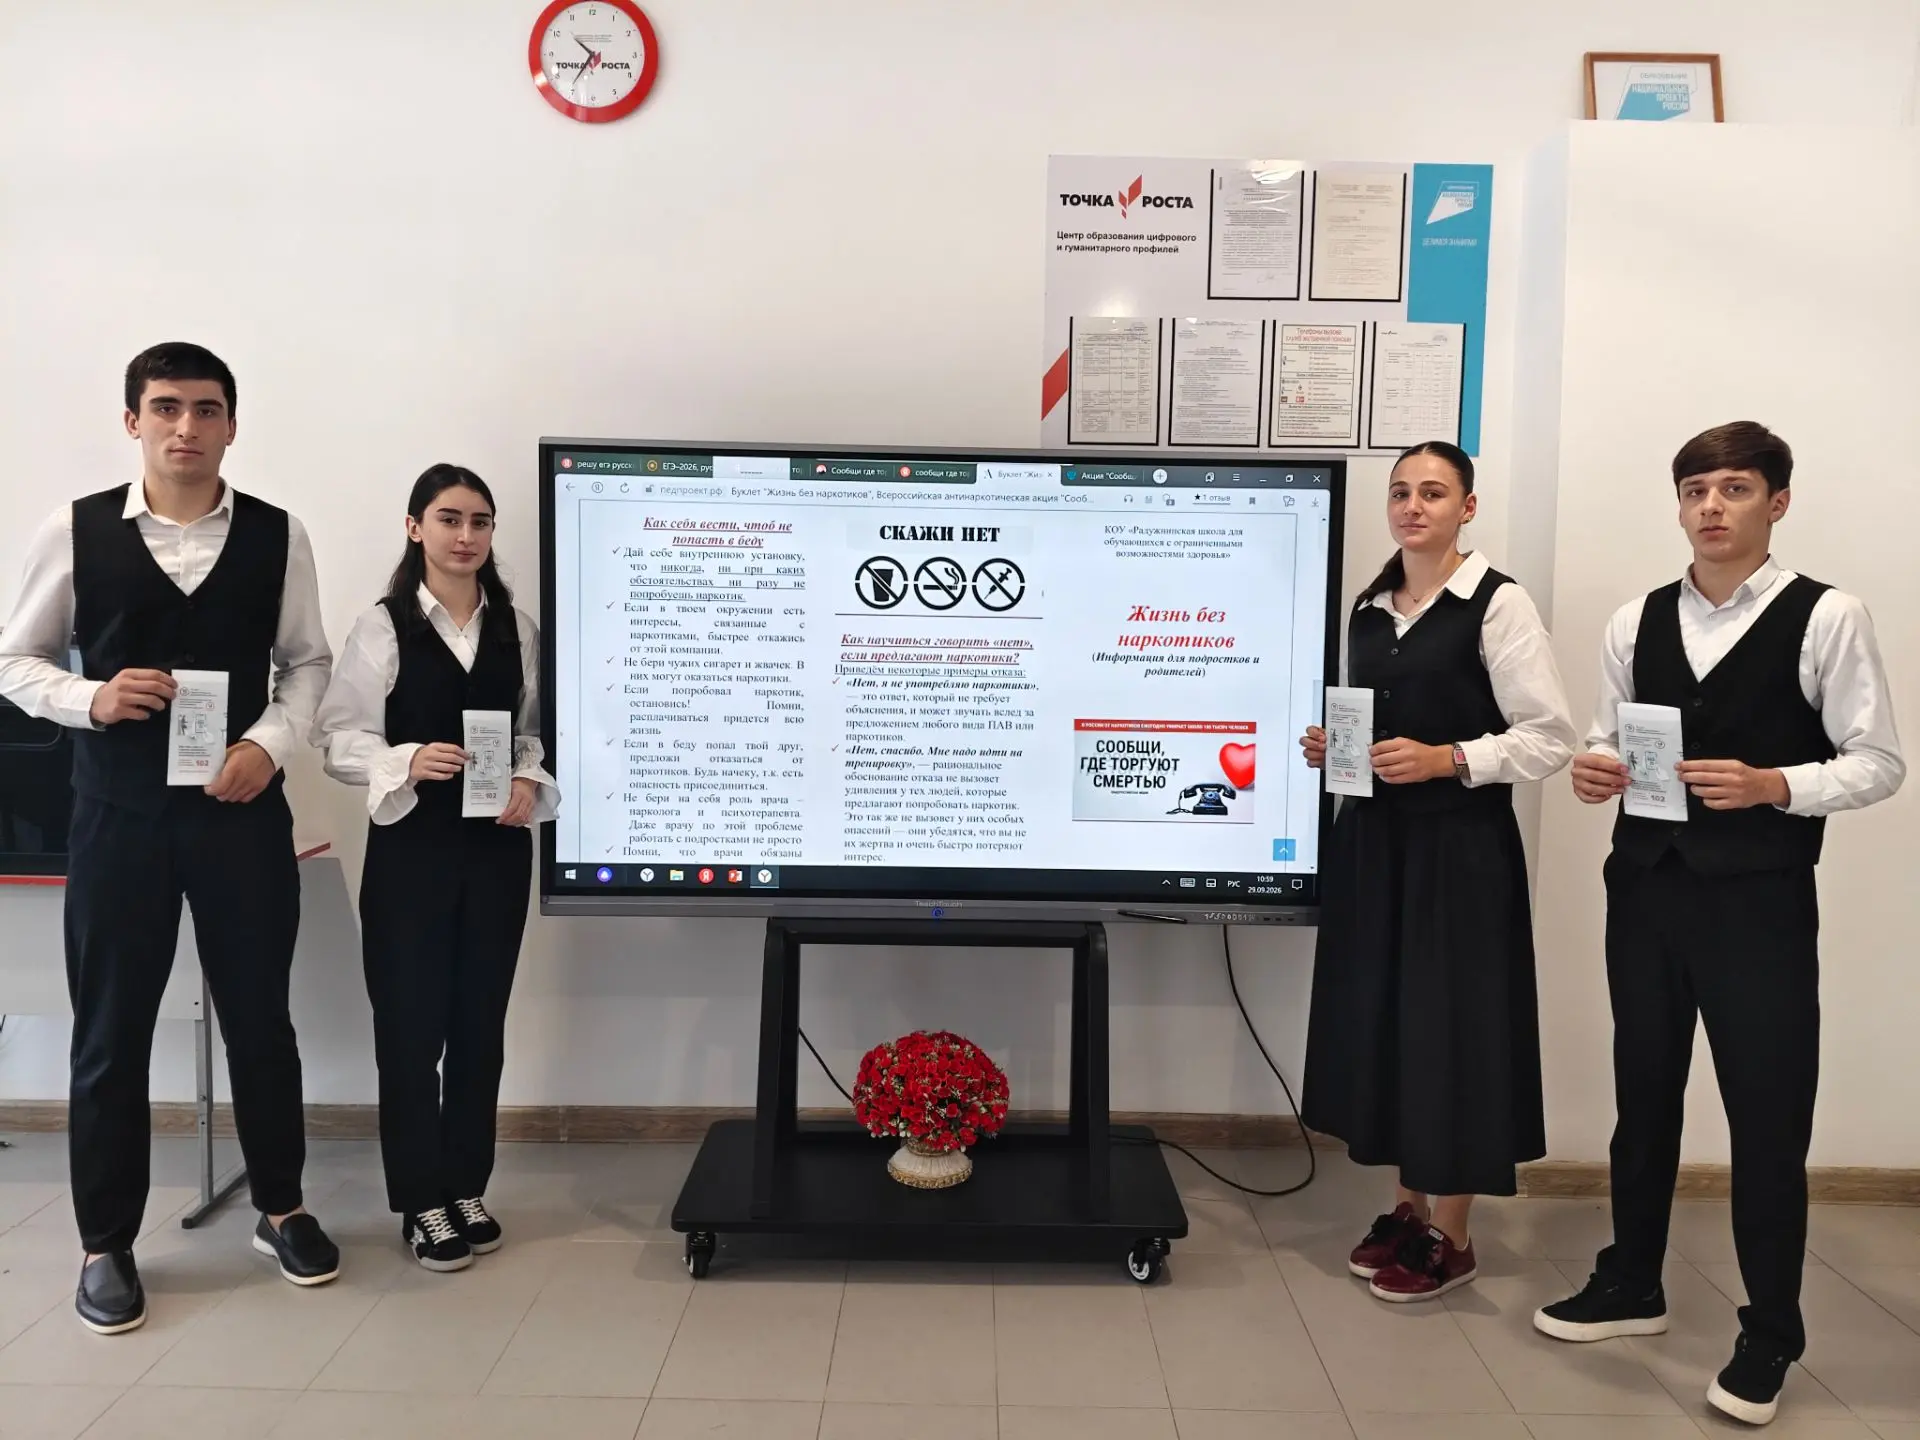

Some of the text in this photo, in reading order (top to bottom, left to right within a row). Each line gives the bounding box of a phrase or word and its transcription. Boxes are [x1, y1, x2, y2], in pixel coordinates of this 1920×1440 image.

[1060, 194, 1194, 209] ТОЧКА РОСТА
[1057, 231, 1196, 244] Центр образования цифрового
[1064, 244, 1130, 255] гуманитарного
[1132, 244, 1179, 255] профилей
[577, 460, 597, 470] решу
[599, 462, 610, 470] егэ
[831, 467, 861, 476] Сообщи
[916, 469, 944, 478] сообщи
[946, 470, 958, 478] где
[1082, 471, 1104, 481] Акция
[731, 488, 761, 497] Буклет
[798, 489, 814, 498] без
[876, 491, 942, 501] Всероссийская
[944, 493, 1030, 503] антинаркотическая
[1032, 494, 1058, 503] акция
[643, 517, 792, 532] Как себя вести, чтоб не
[1104, 525, 1125, 535] КОУ
[1197, 527, 1225, 536] школа
[1228, 528, 1243, 537] для
[880, 525, 1000, 542] СКАЖИ НЕТ
[673, 535, 764, 548] попасть в беду
[1127, 605, 1226, 623] Жизнь без
[841, 634, 1034, 650] Как научиться говорить «нет»,
[1118, 633, 1235, 651] наркотиков
[841, 651, 1020, 664] если предлагают наркотики?
[1092, 652, 1164, 664] (Информация
[1168, 654, 1185, 664] для
[1189, 655, 1250, 666] подростков
[1144, 667, 1206, 678] родителей)
[906, 680, 970, 691] употребляю
[928, 747, 949, 756] Мне
[953, 748, 977, 757] надо
[980, 748, 1007, 758] идти
[1096, 740, 1165, 756] СООБЩИ,
[1081, 757, 1180, 773] ГДЕ ТОРГУЮТ
[1093, 775, 1166, 788] СМЕРТЬЮ
[1651, 794, 1665, 802] 102
